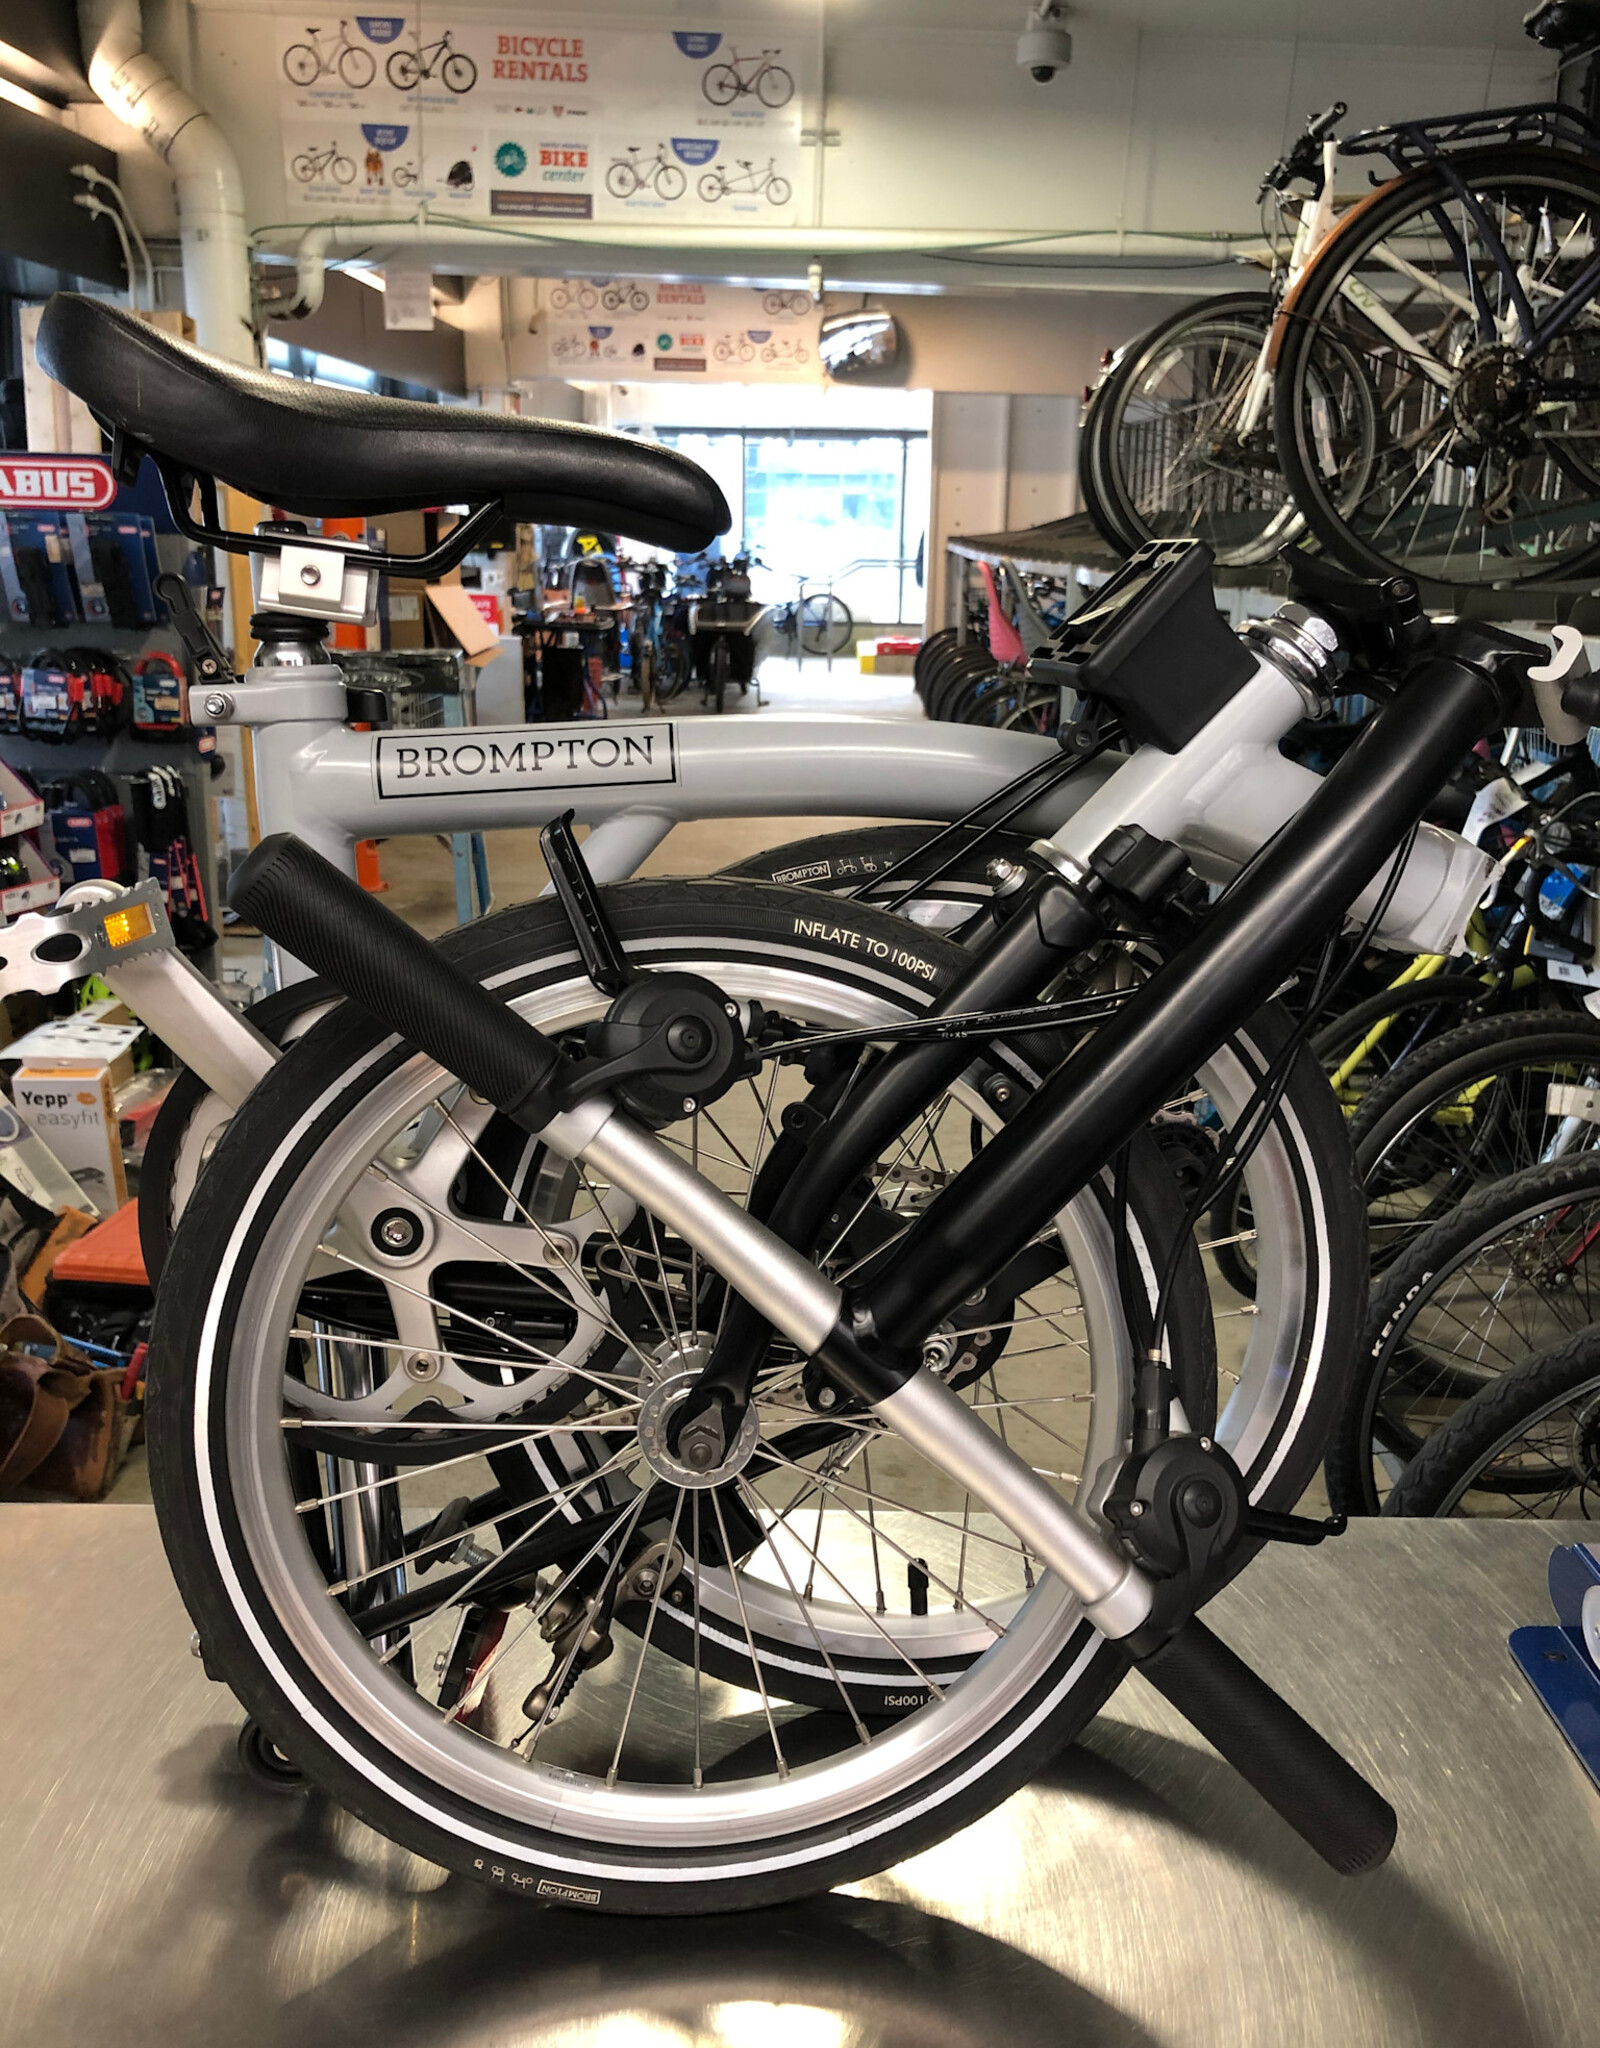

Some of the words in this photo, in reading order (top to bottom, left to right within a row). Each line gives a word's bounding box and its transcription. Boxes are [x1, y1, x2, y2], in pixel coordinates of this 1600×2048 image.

[497, 35, 583, 58] BICYCLE
[493, 60, 588, 82] RENTALS
[540, 150, 588, 168] BIKE
[542, 168, 585, 182] center
[396, 735, 654, 779] BROMPTON
[776, 864, 828, 884] BROMPTON
[794, 919, 861, 949] INFLATE
[866, 937, 889, 958] TO
[891, 949, 938, 982] 100PSI
[21, 1091, 68, 1109] Yepp
[37, 1110, 100, 1130] easyfit
[1371, 1271, 1434, 1358] KENDA
[884, 1695, 924, 1706] 100PSI
[541, 1884, 597, 1902] BROMPTON
